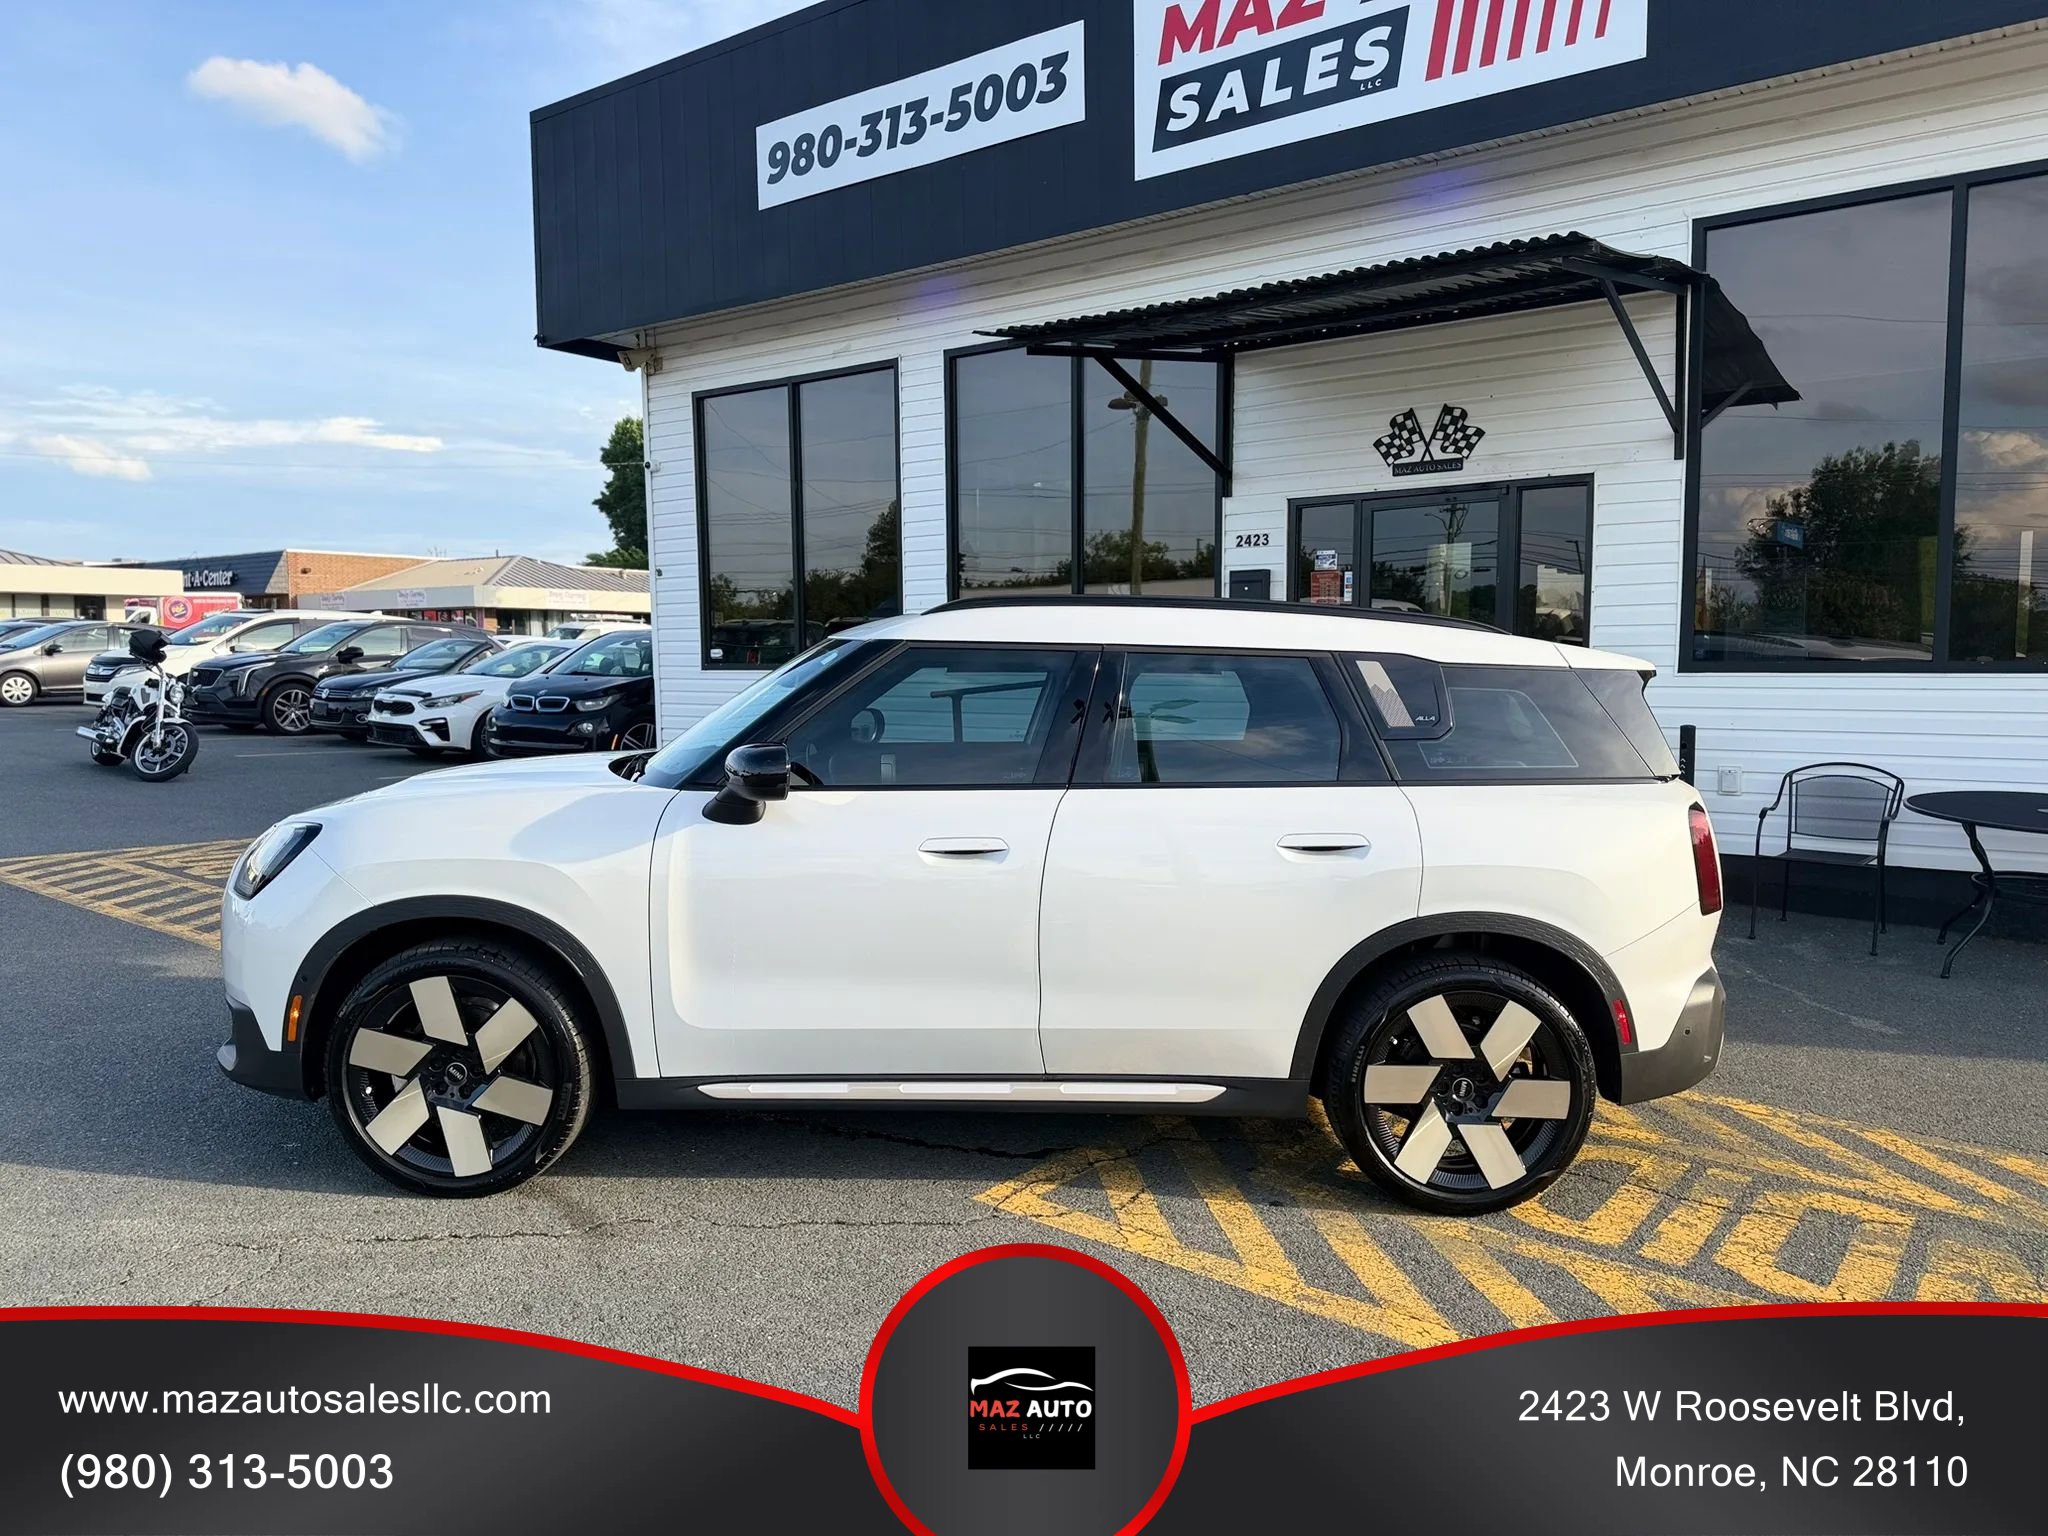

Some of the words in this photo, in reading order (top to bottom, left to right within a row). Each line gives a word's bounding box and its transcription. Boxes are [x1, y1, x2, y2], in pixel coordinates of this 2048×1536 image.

[1166, 25, 1392, 132] SALES
[1359, 78, 1382, 91] LLC
[766, 50, 1070, 185] 980-313-5003
[1394, 466, 1413, 475] MAZ
[1413, 463, 1436, 472] AUTO
[1436, 461, 1461, 470] SALES
[1235, 533, 1270, 548] 2423
